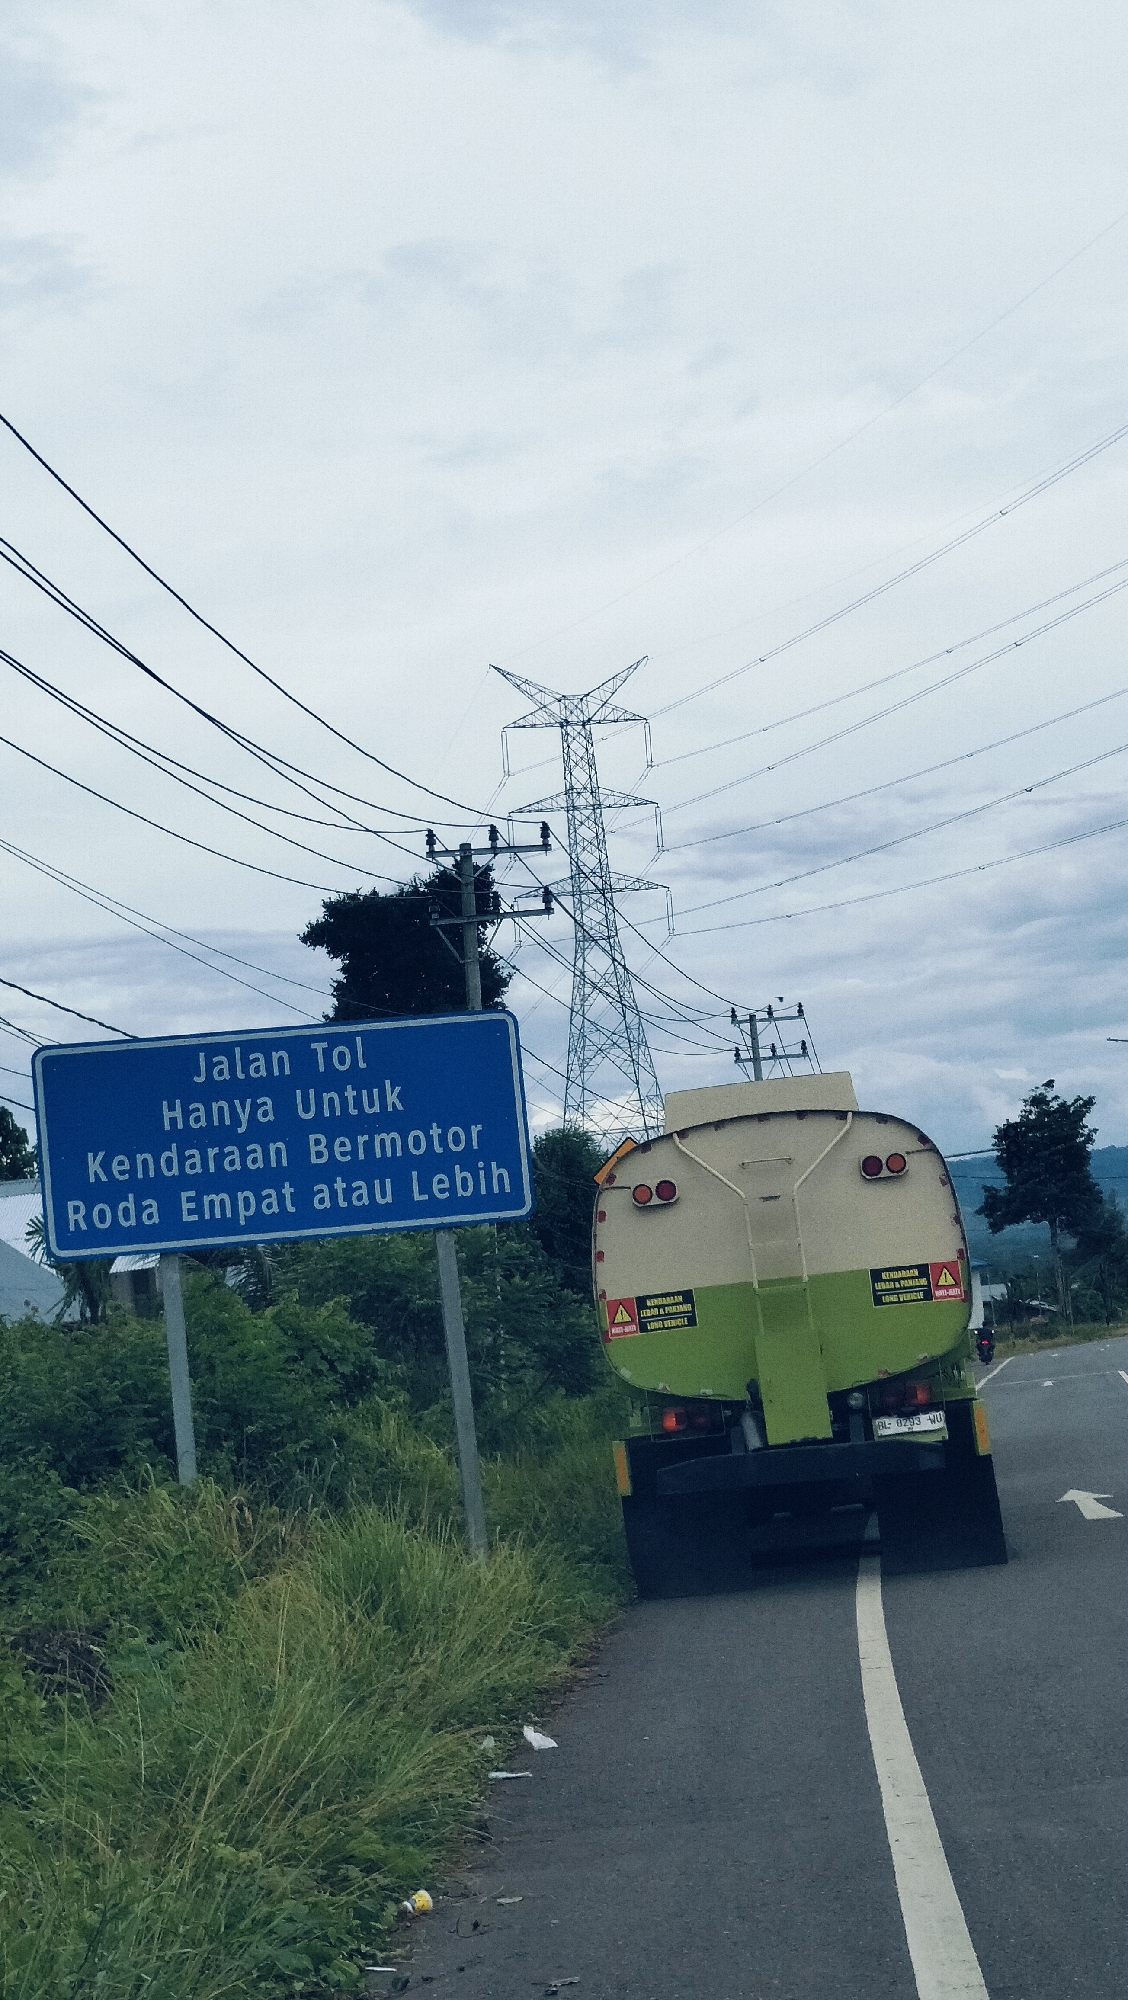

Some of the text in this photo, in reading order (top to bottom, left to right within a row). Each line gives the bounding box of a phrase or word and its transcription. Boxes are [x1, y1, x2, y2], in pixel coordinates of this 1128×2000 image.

[193, 1036, 367, 1083] Jalan Tol
[162, 1079, 404, 1134] Hanya Untuk
[87, 1122, 483, 1183] Kendaraan Bermotor
[67, 1161, 511, 1232] Roda Empat atau Lebih
[881, 1269, 919, 1280] KENDARAAN
[646, 1295, 683, 1307] KENDARAAN
[882, 1291, 924, 1303] LONG VEHICLE
[647, 1317, 688, 1330] LONG VEHICLE
